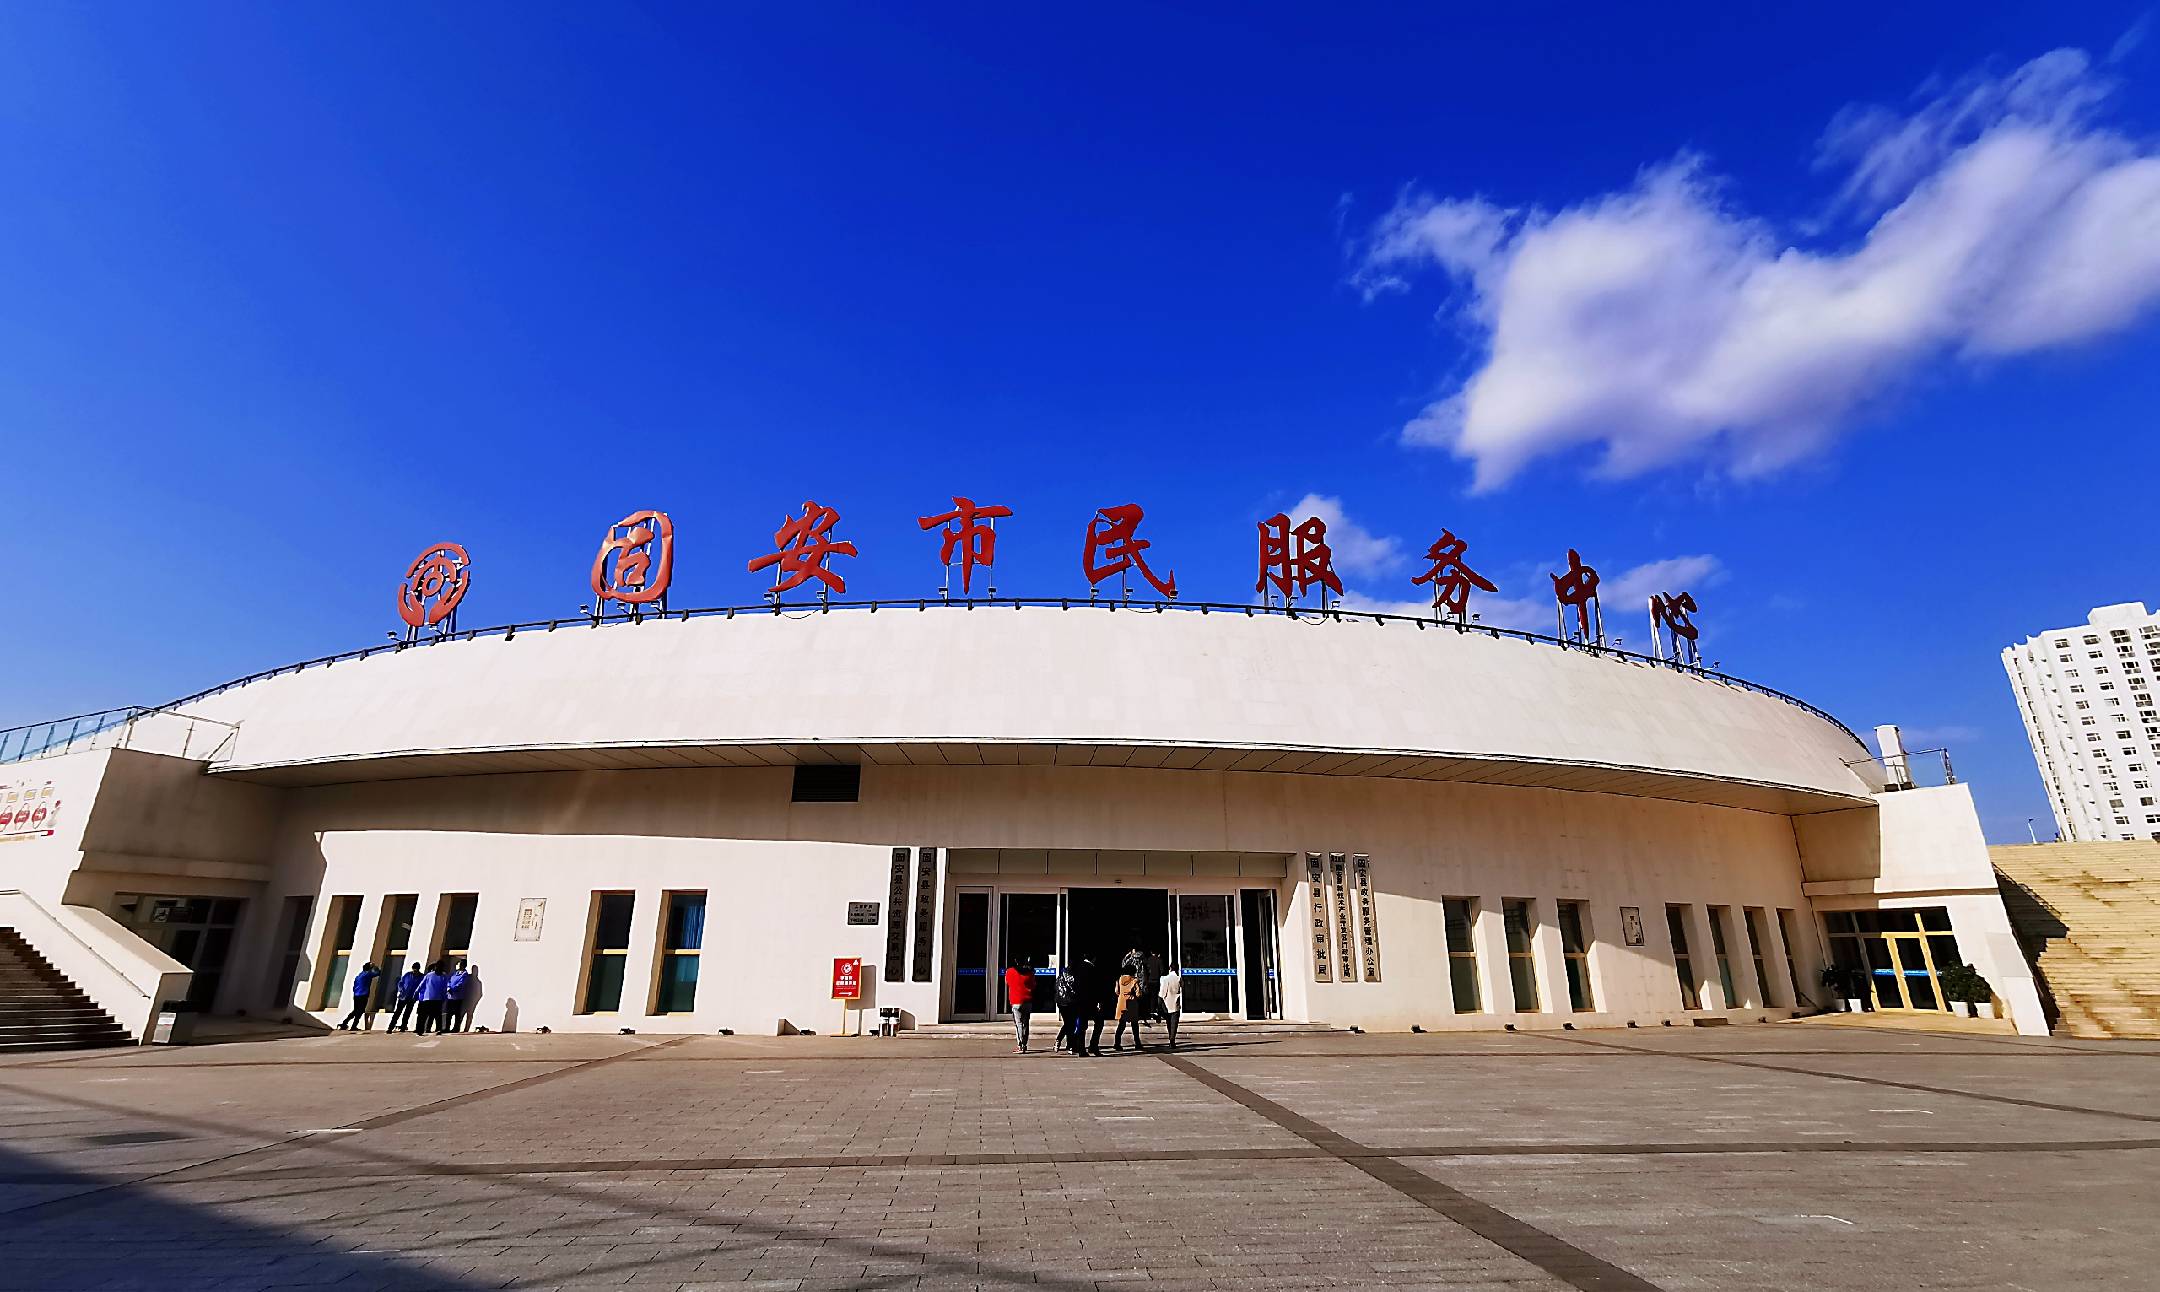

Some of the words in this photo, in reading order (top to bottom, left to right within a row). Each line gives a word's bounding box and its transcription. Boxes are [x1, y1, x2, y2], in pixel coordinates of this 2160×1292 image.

[591, 496, 1698, 641] 固安市民服务中心
[1311, 858, 1327, 976] 固安县行政审批局
[1357, 859, 1375, 977] 固安县政务服务管理办公室
